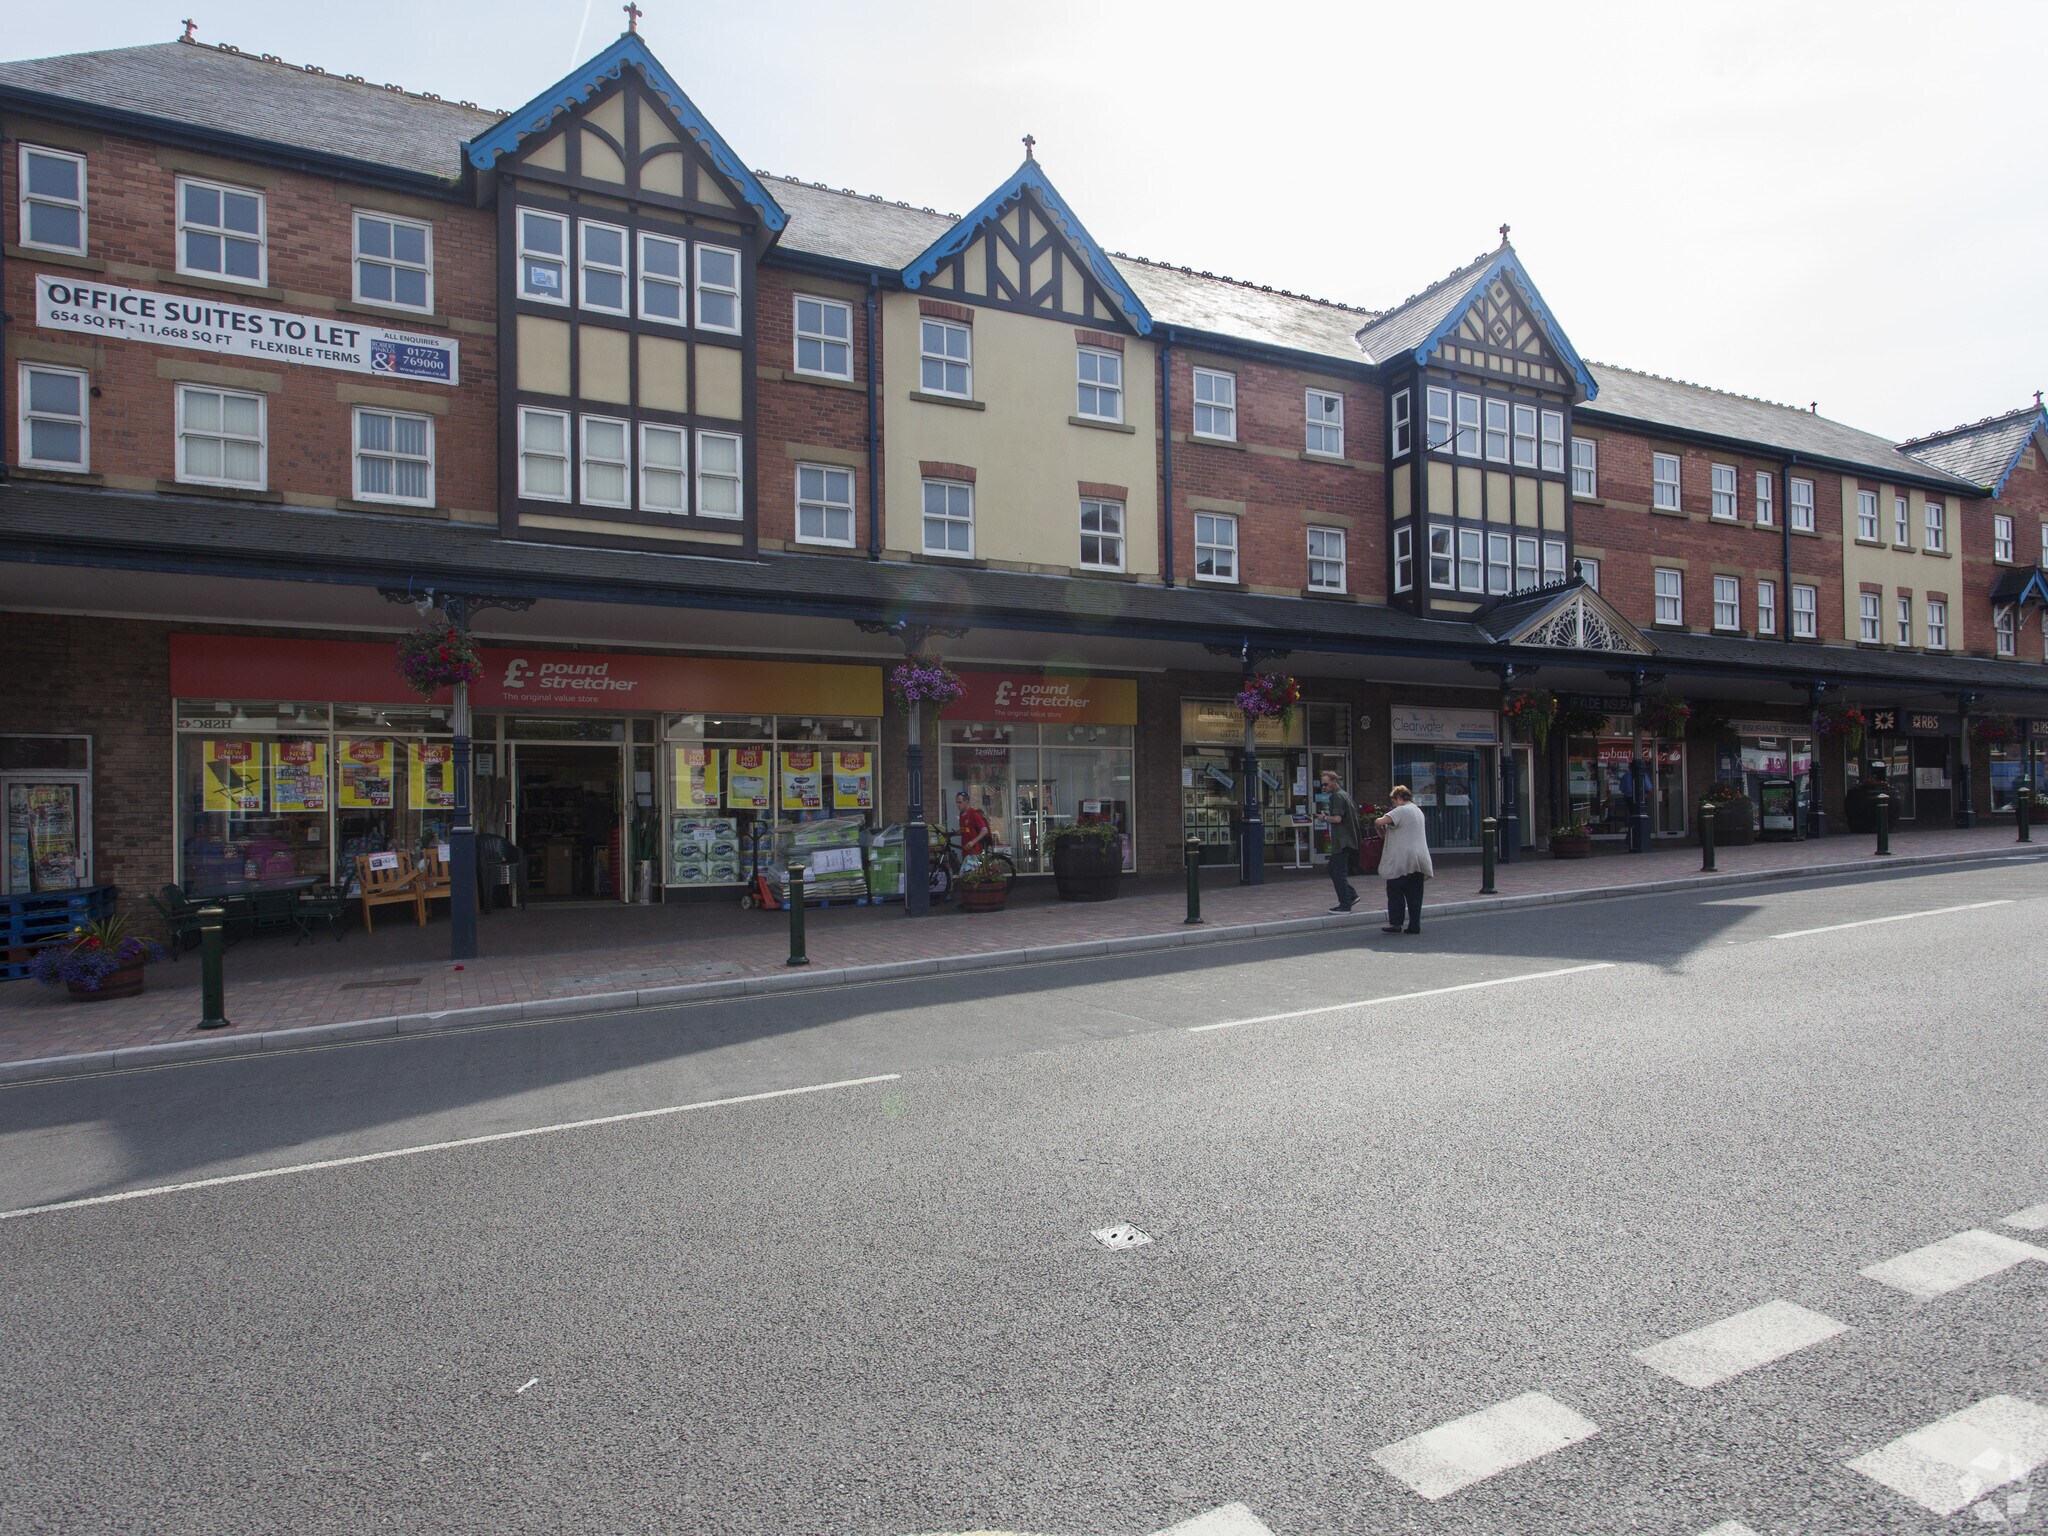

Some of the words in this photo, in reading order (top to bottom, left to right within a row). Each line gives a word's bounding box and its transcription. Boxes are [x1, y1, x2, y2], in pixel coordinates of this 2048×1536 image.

[47, 283, 157, 319] OFFICE
[164, 302, 263, 335] SUITES
[269, 317, 307, 340] TO
[314, 324, 361, 348] LET
[50, 309, 80, 323] 654
[83, 314, 105, 328] SQ
[108, 317, 127, 330] FT
[139, 322, 188, 339] 11,668
[191, 330, 212, 344] SQ
[215, 334, 233, 346] FT
[383, 332, 399, 342] ALL
[399, 334, 440, 347] ENQUIRIES
[250, 339, 313, 358] FLEXIBLE
[315, 348, 361, 364] TERMS
[407, 347, 439, 360] 01772
[371, 352, 394, 372] &
[402, 355, 444, 370] 769000
[539, 662, 609, 677] pound
[539, 675, 638, 691] stretcher
[1020, 684, 1069, 696] pound
[502, 692, 518, 701] The
[520, 693, 551, 702] original
[553, 694, 576, 702] value
[577, 695, 599, 703] store
[1020, 695, 1090, 708] stretcher
[1603, 698, 1633, 711] INSURA
[1393, 717, 1444, 732] Clearwater
[1742, 723, 1779, 732] INSURANCE
[1921, 715, 1939, 729] RBS
